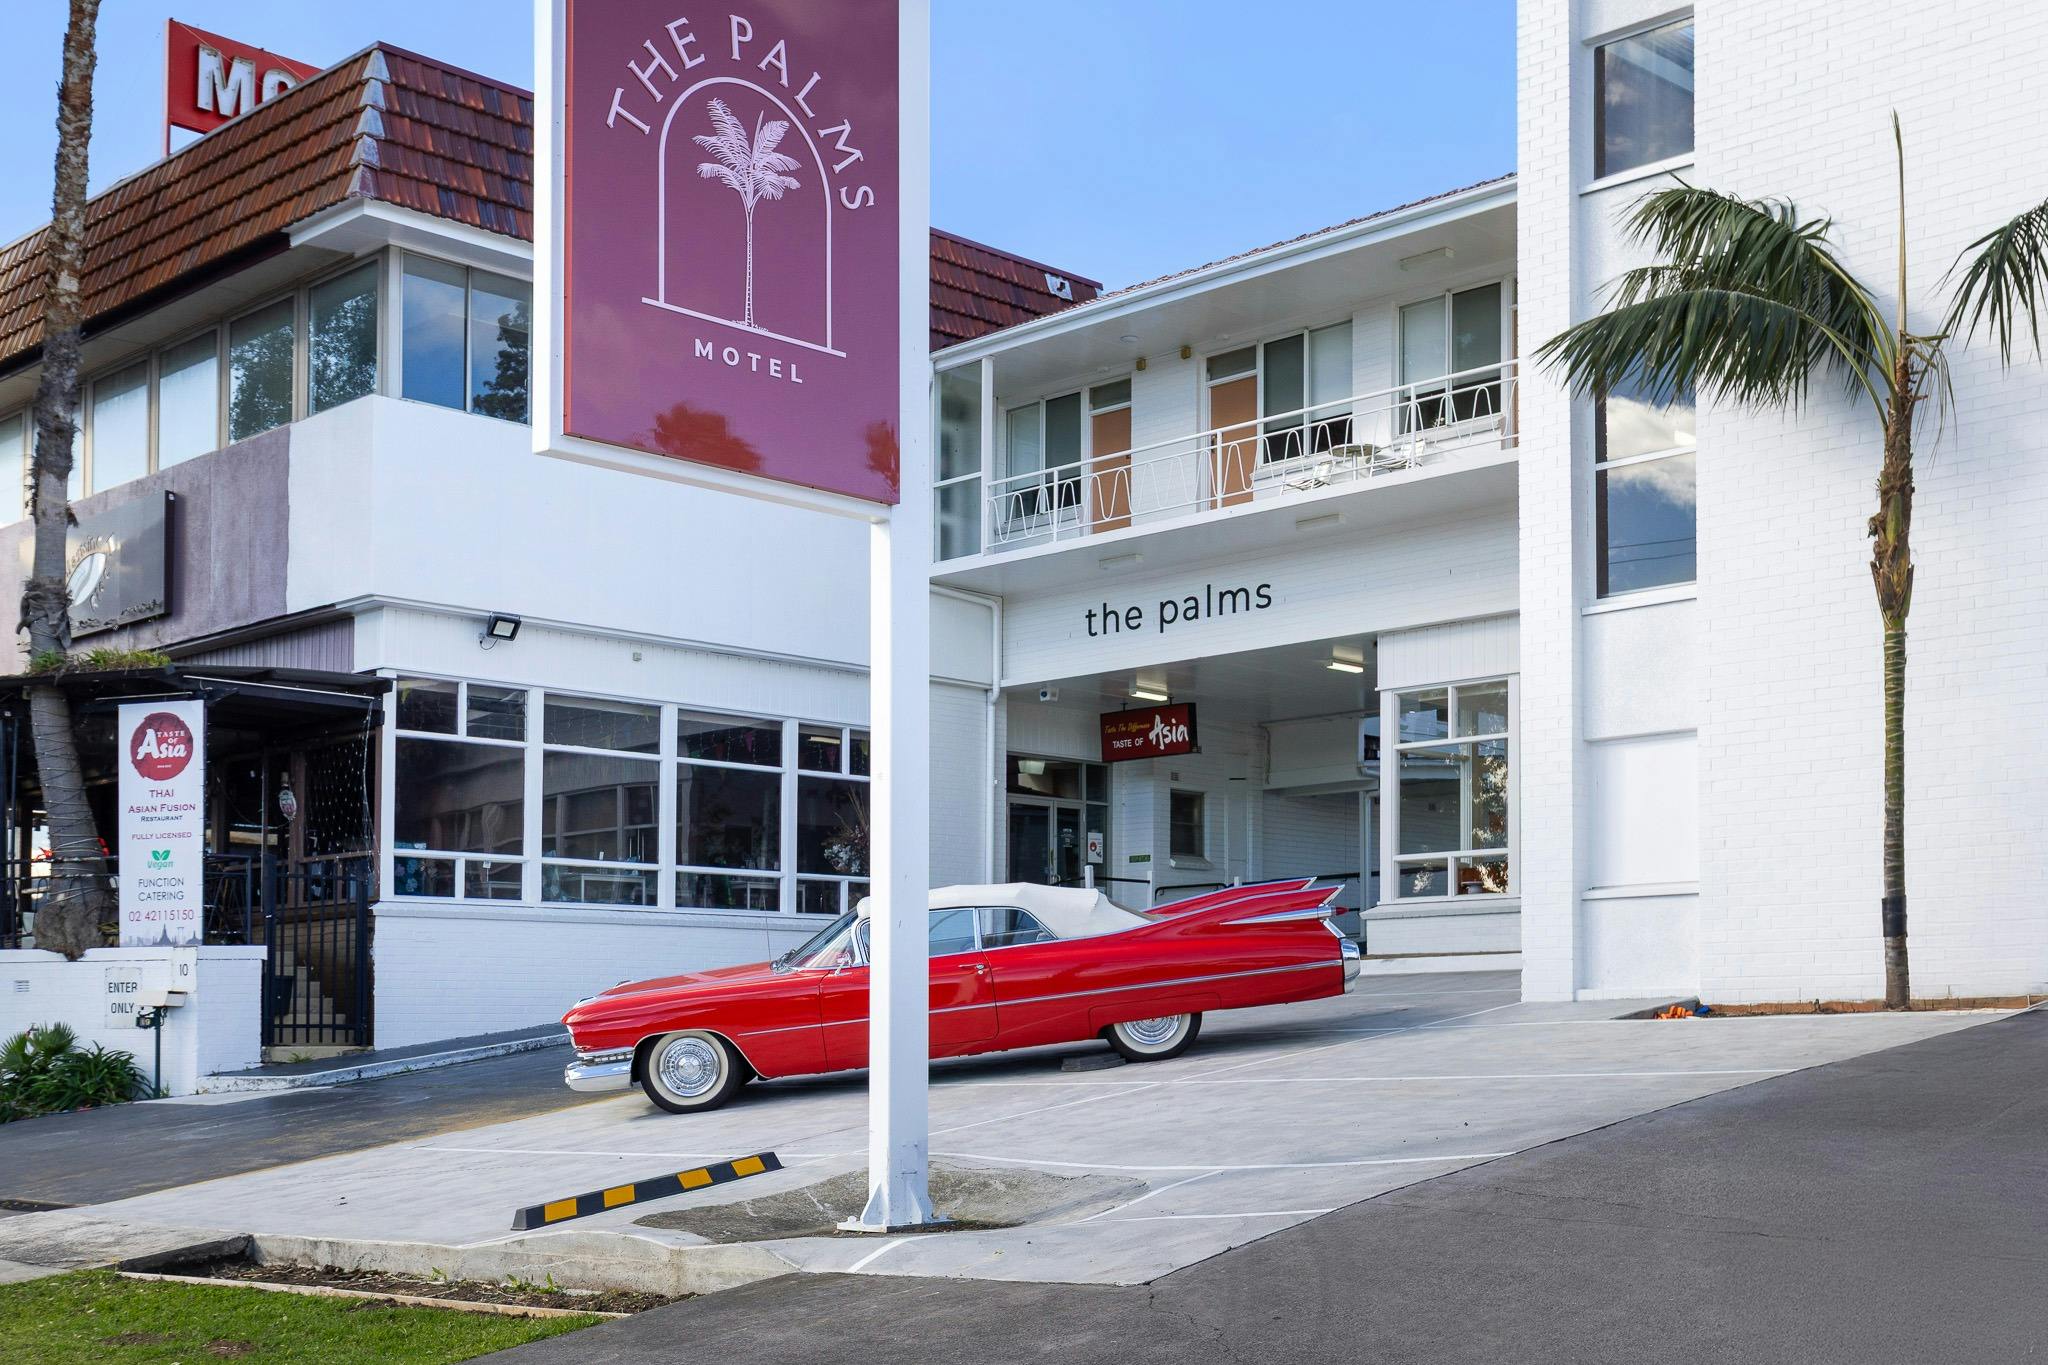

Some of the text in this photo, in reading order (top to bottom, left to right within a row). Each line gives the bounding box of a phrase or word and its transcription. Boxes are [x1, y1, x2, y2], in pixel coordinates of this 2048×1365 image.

[606, 14, 875, 210] THE PALMS
[694, 338, 803, 384] MOTEL
[1085, 583, 1272, 637] the palms
[1112, 714, 1189, 750] TASTE OF Asia
[136, 728, 188, 760] Asia
[149, 789, 174, 798] THAI
[128, 803, 196, 813] ASIAN FUSION
[155, 831, 192, 839] LICENSED
[147, 861, 174, 870] Vegan
[138, 877, 184, 888] FUNCTION
[138, 890, 185, 902] CATERING
[128, 909, 194, 922] 02 42115150
[108, 982, 138, 993] ENTER
[110, 1002, 134, 1014] ONLY
